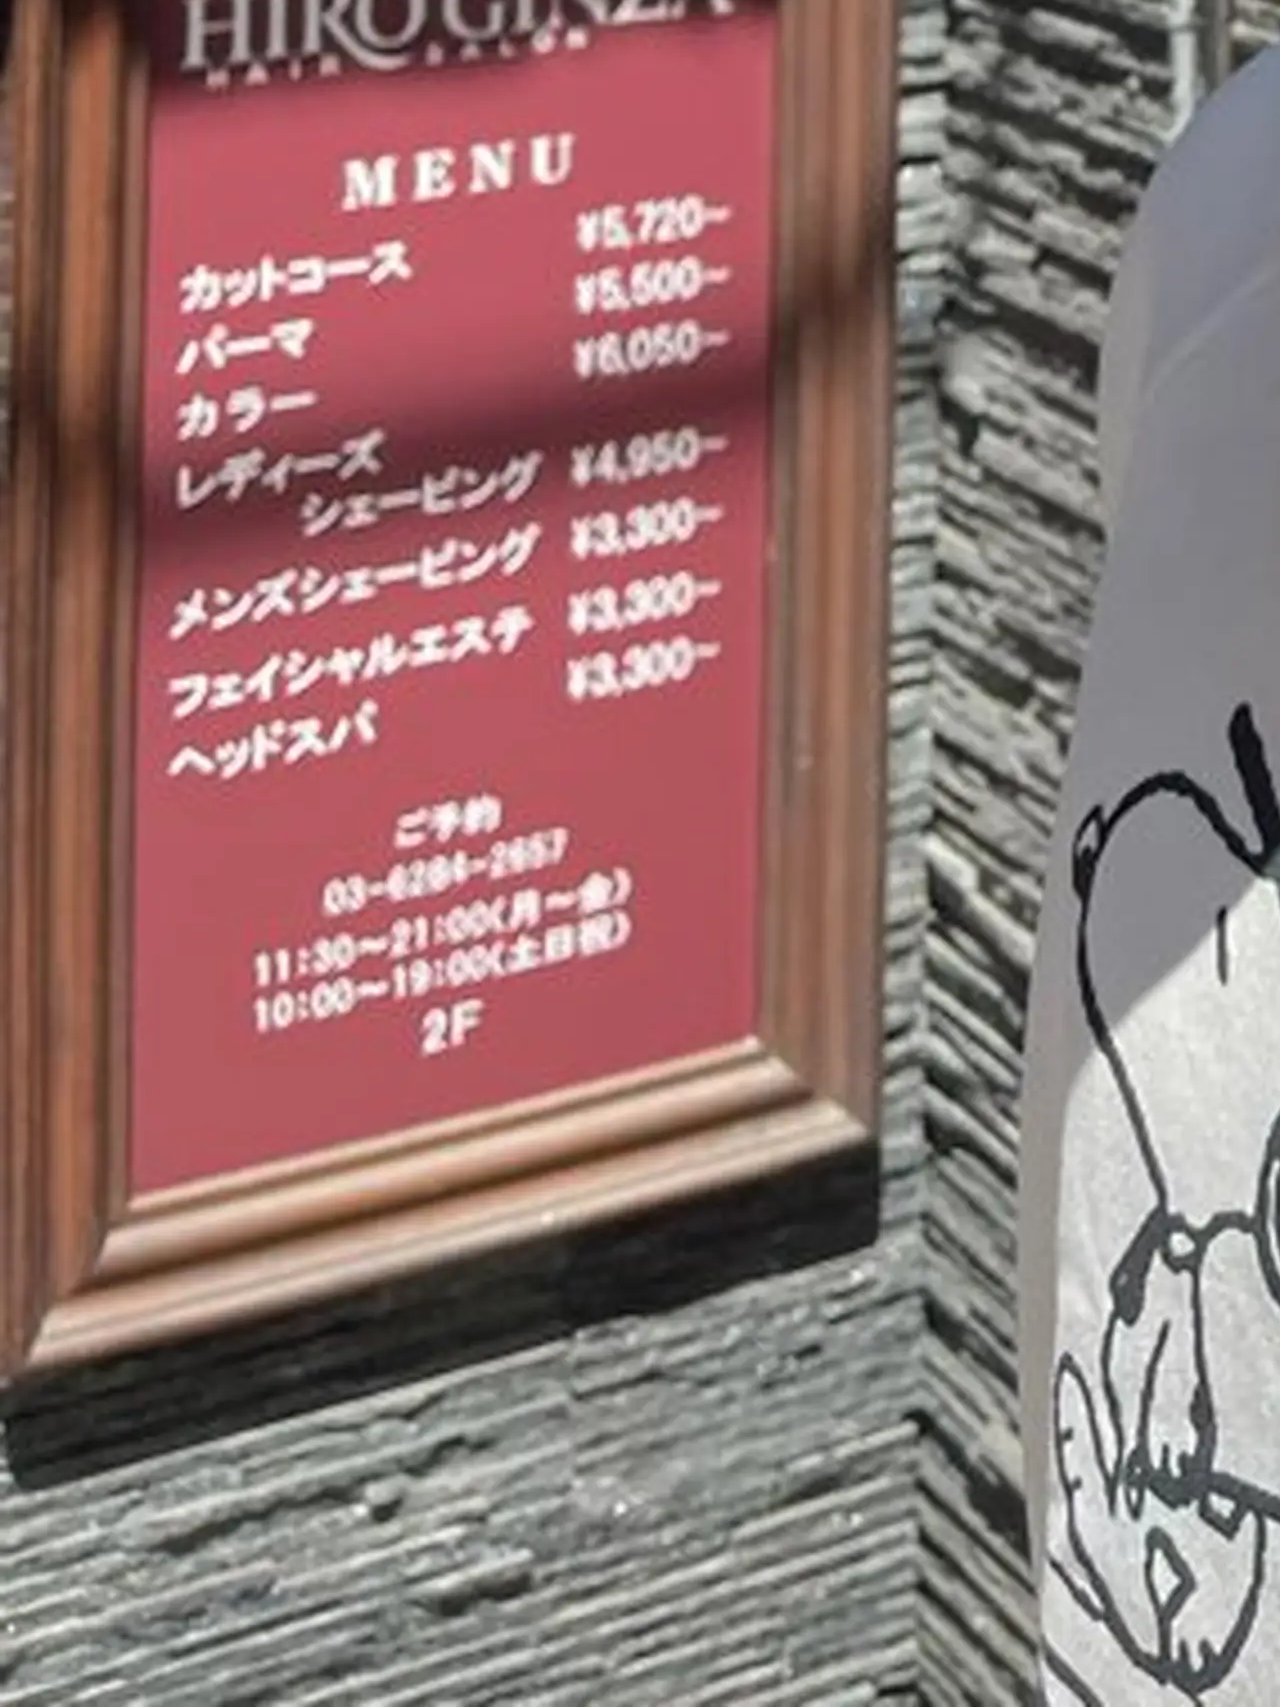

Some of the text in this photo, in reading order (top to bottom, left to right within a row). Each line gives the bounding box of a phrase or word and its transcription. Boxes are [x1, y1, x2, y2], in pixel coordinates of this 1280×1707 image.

[341, 132, 576, 212] MENU
[179, 239, 413, 314] カットコース
[174, 317, 315, 376] パーマ
[177, 384, 319, 443] カラー
[175, 427, 387, 510] レディース
[301, 449, 544, 538] シェービング
[168, 521, 543, 641] メンズシェービング
[167, 604, 535, 720] フェイシャルエステ
[166, 697, 380, 781] ヘッドスパ
[419, 997, 486, 1056] 2F
